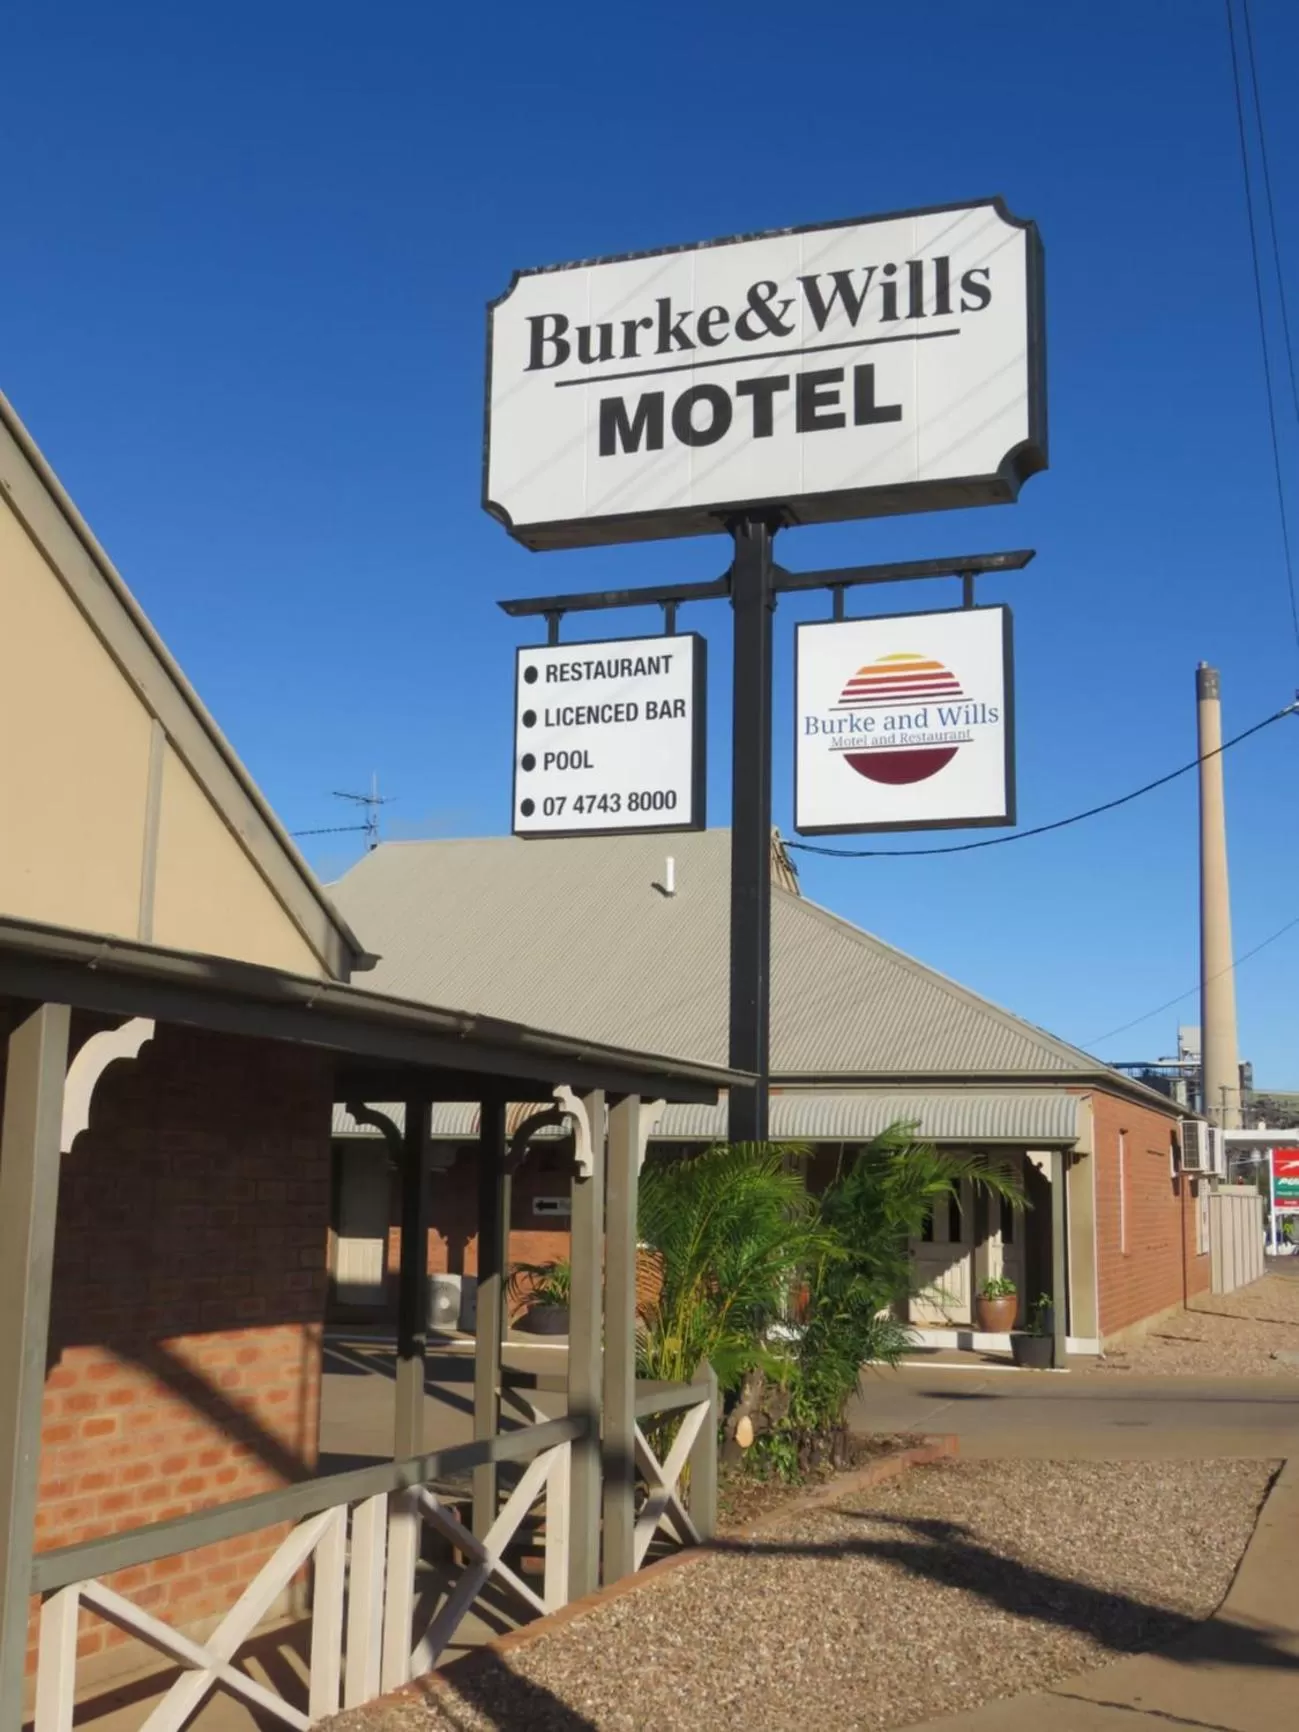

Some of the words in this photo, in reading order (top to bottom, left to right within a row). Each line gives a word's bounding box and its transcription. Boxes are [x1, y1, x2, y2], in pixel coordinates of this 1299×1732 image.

[524, 255, 991, 372] Burke&Wills
[599, 363, 902, 457] MOTEL
[546, 654, 673, 683] RESTAURANT
[545, 702, 639, 726] LICENCED
[645, 698, 686, 720] BAR
[805, 712, 875, 736] Burke
[883, 708, 928, 731] and
[936, 703, 999, 726] Wills
[831, 734, 868, 748] Motel
[871, 732, 896, 746] and
[899, 728, 971, 744] Restaurant
[544, 750, 594, 771] POOL
[543, 796, 567, 816] 07
[573, 793, 621, 814] 4743
[627, 790, 677, 812] 8000
